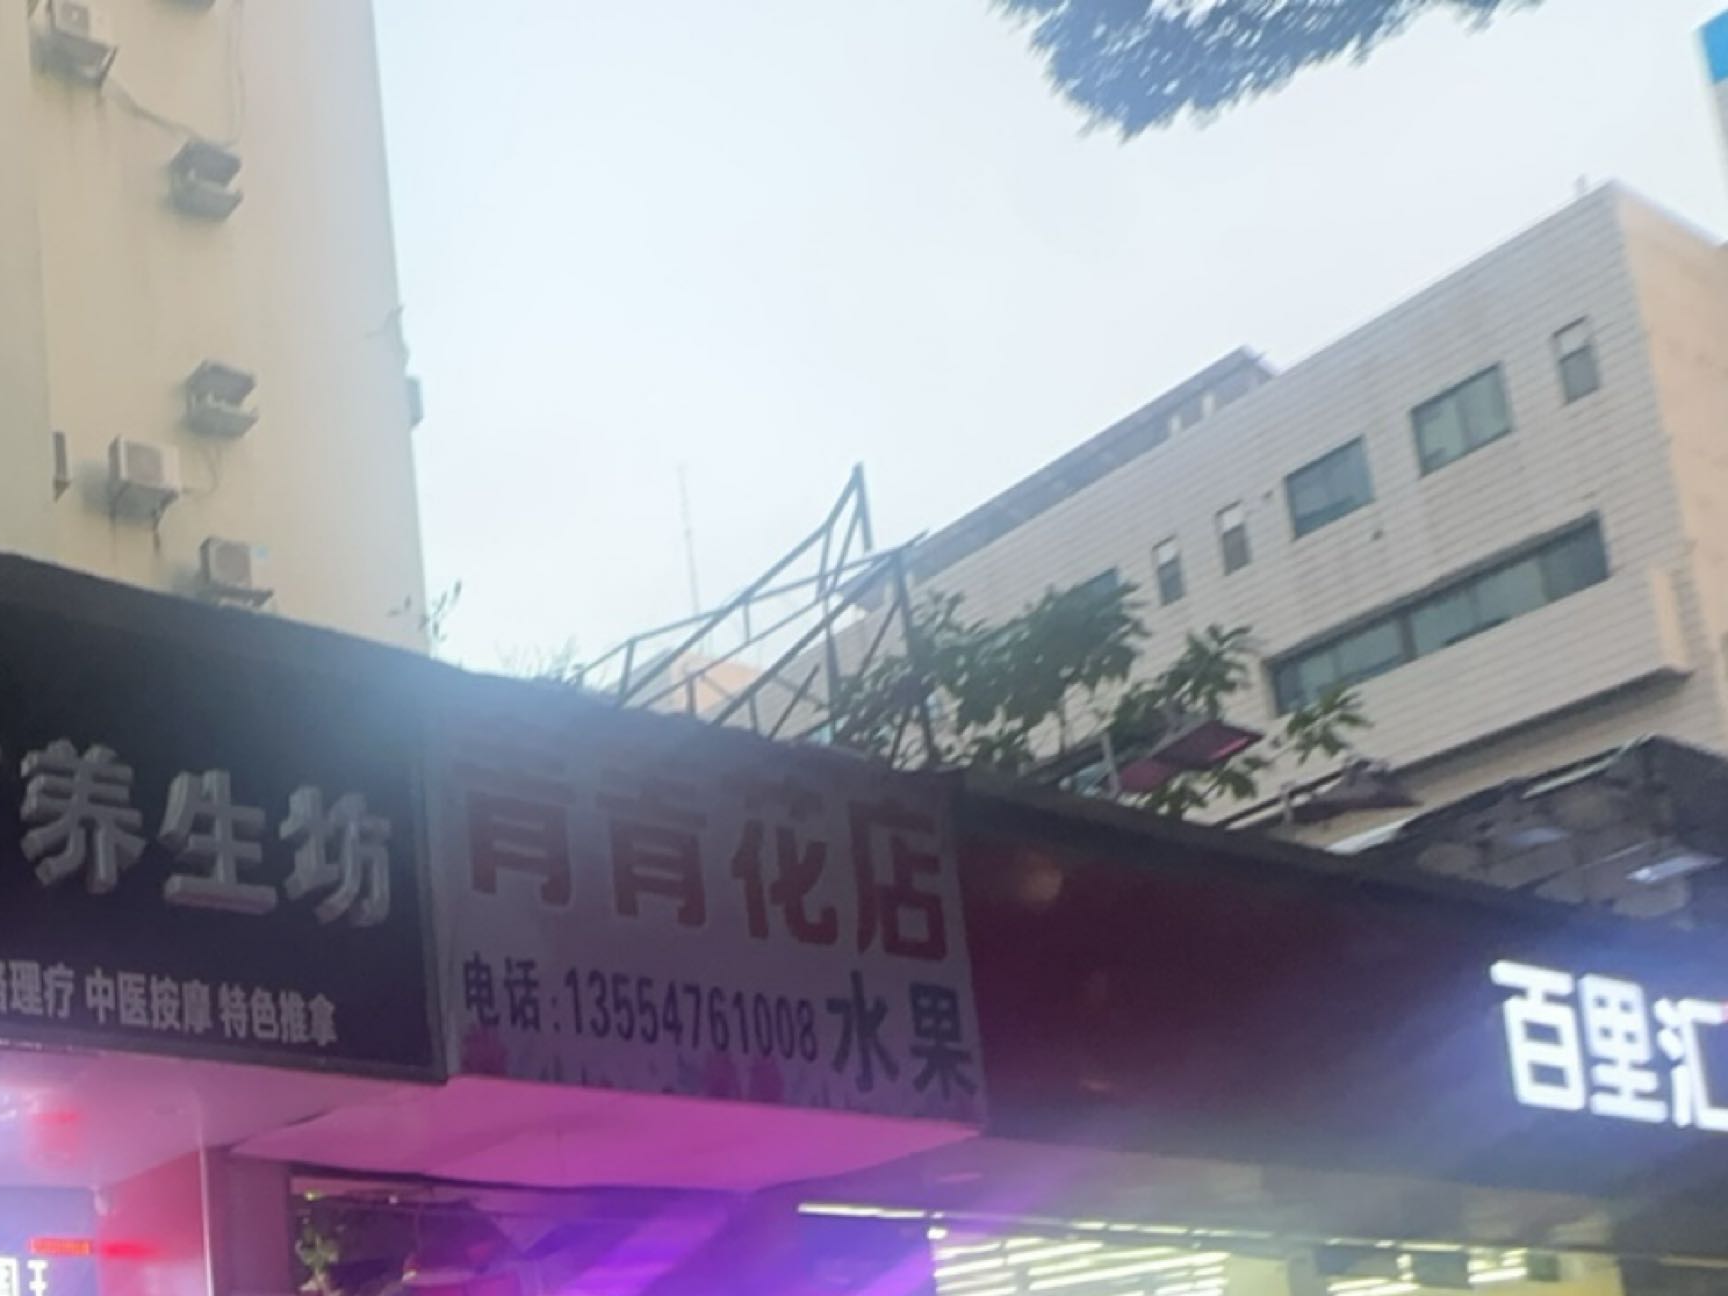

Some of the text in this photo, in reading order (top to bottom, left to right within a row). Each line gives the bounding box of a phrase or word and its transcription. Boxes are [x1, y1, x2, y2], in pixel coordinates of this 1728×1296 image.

[460, 768, 950, 962] 青青花店
[85, 966, 212, 1033] 中医按摩
[219, 982, 338, 1047] 特色推拿
[826, 969, 978, 1098] 水果
[1489, 959, 1728, 1133] 百里汇
